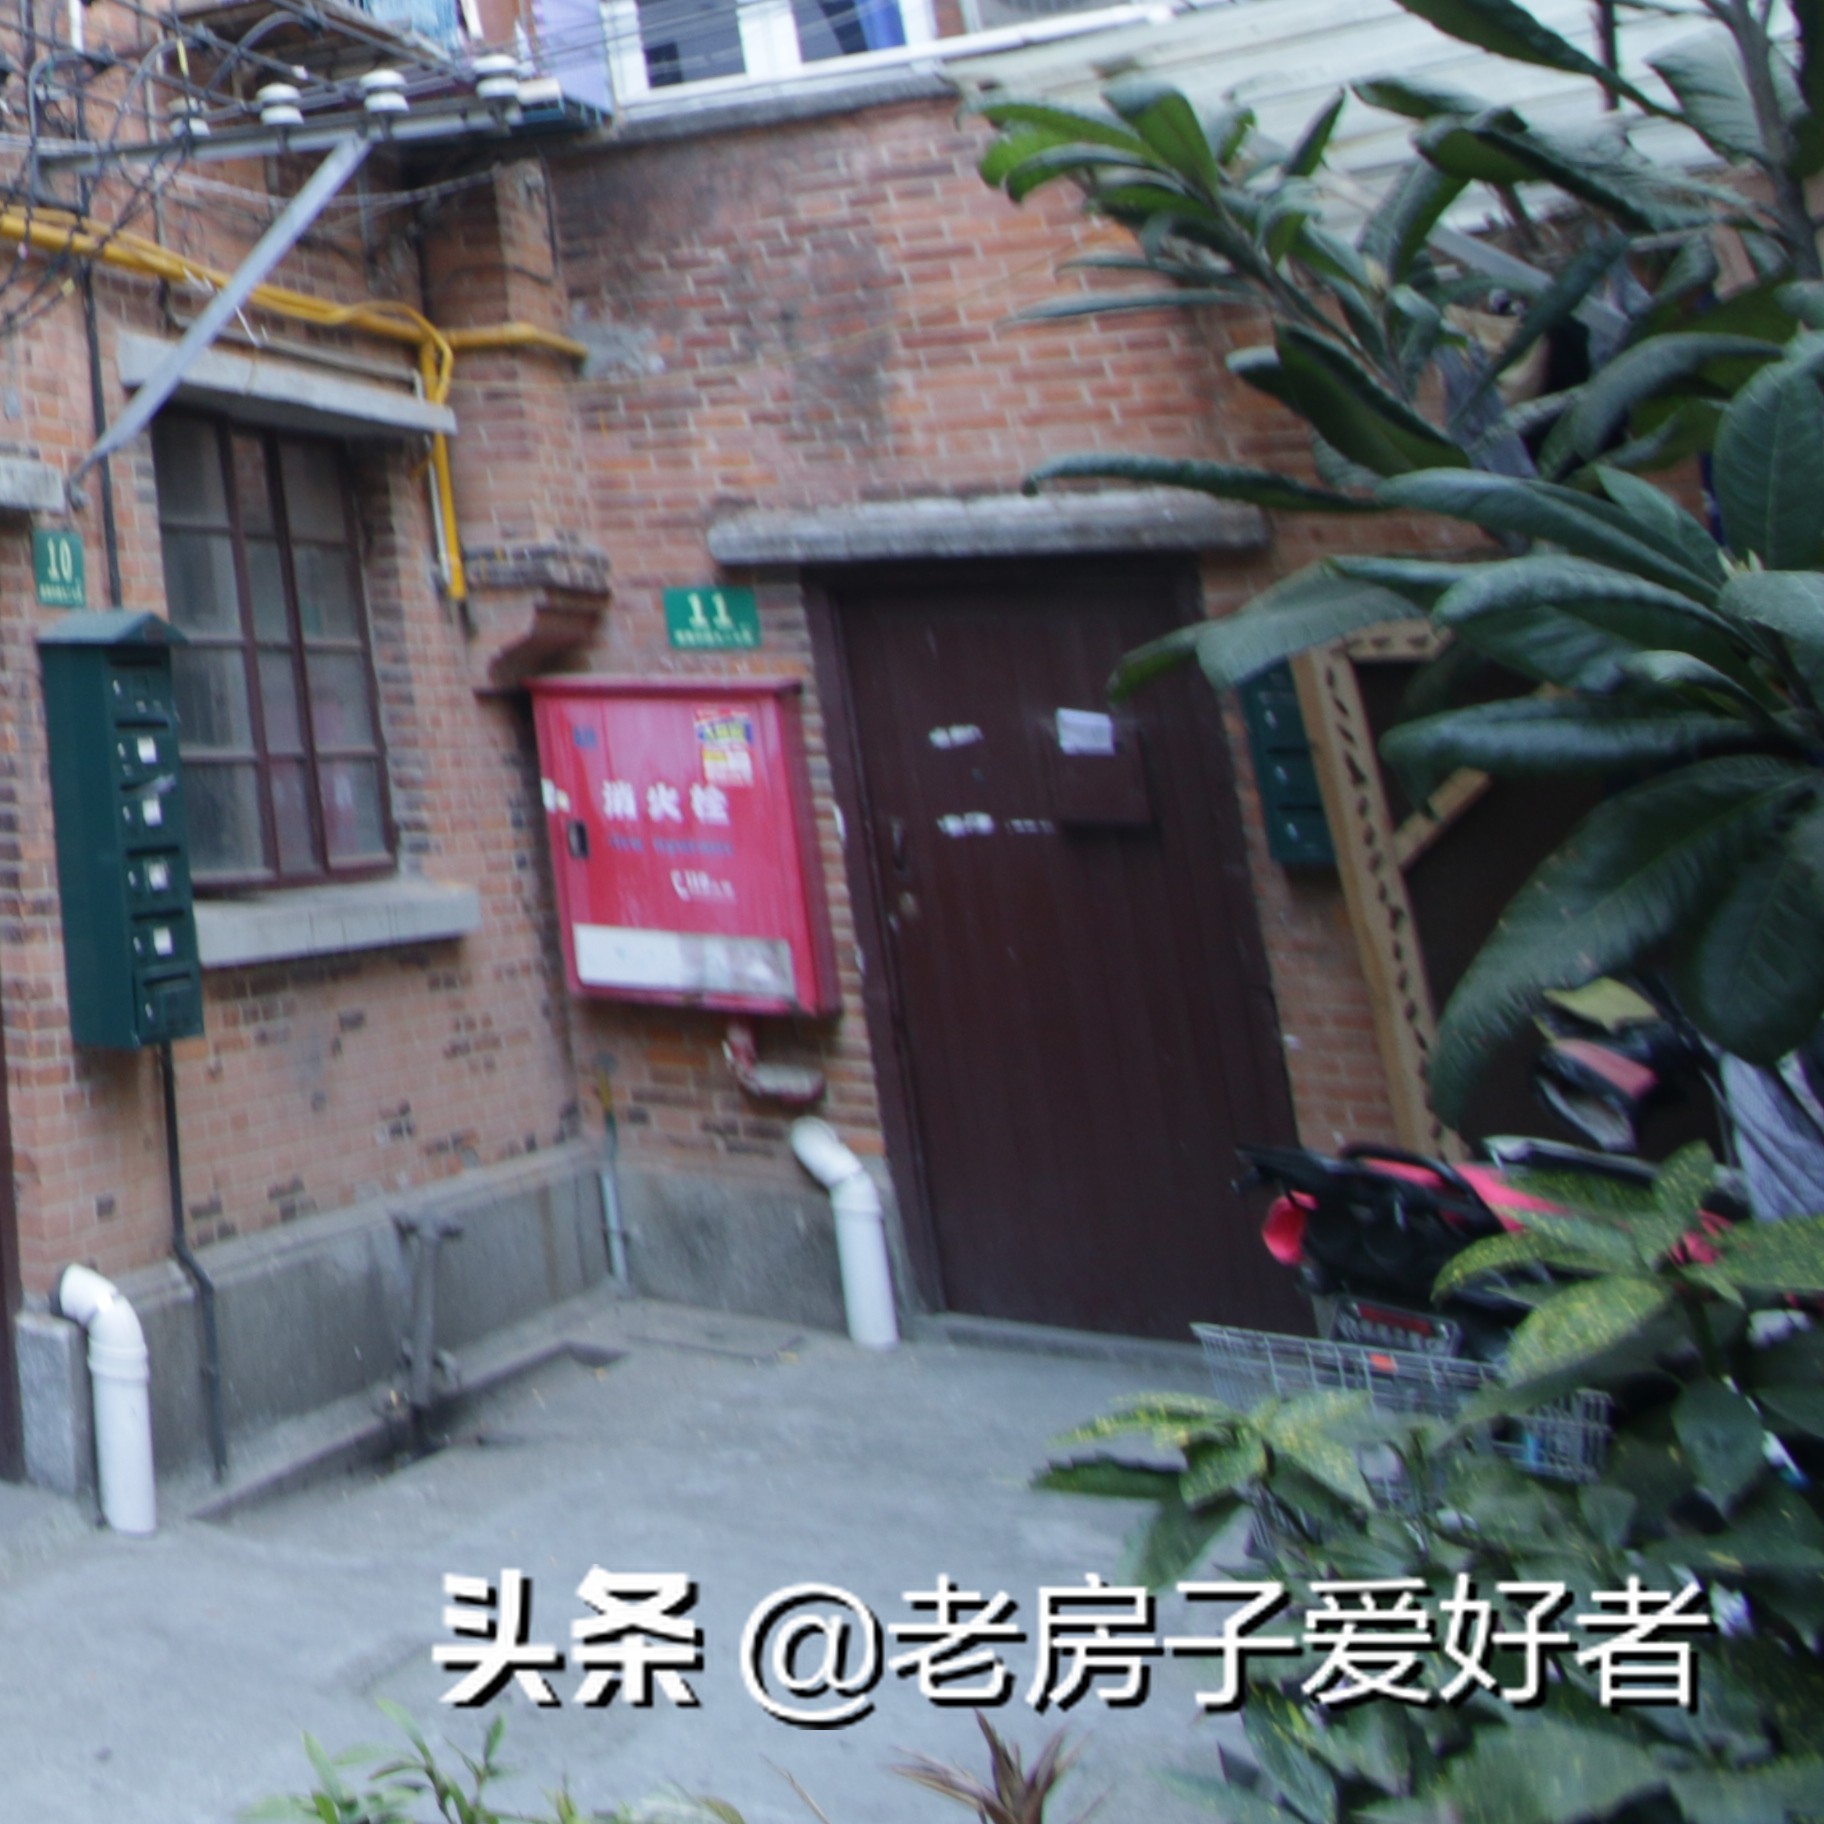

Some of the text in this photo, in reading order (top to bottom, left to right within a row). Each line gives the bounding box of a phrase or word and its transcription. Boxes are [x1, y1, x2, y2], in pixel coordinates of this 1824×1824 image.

[47, 537, 73, 583] 10
[688, 592, 733, 626] 11
[602, 779, 729, 824] 消火栓
